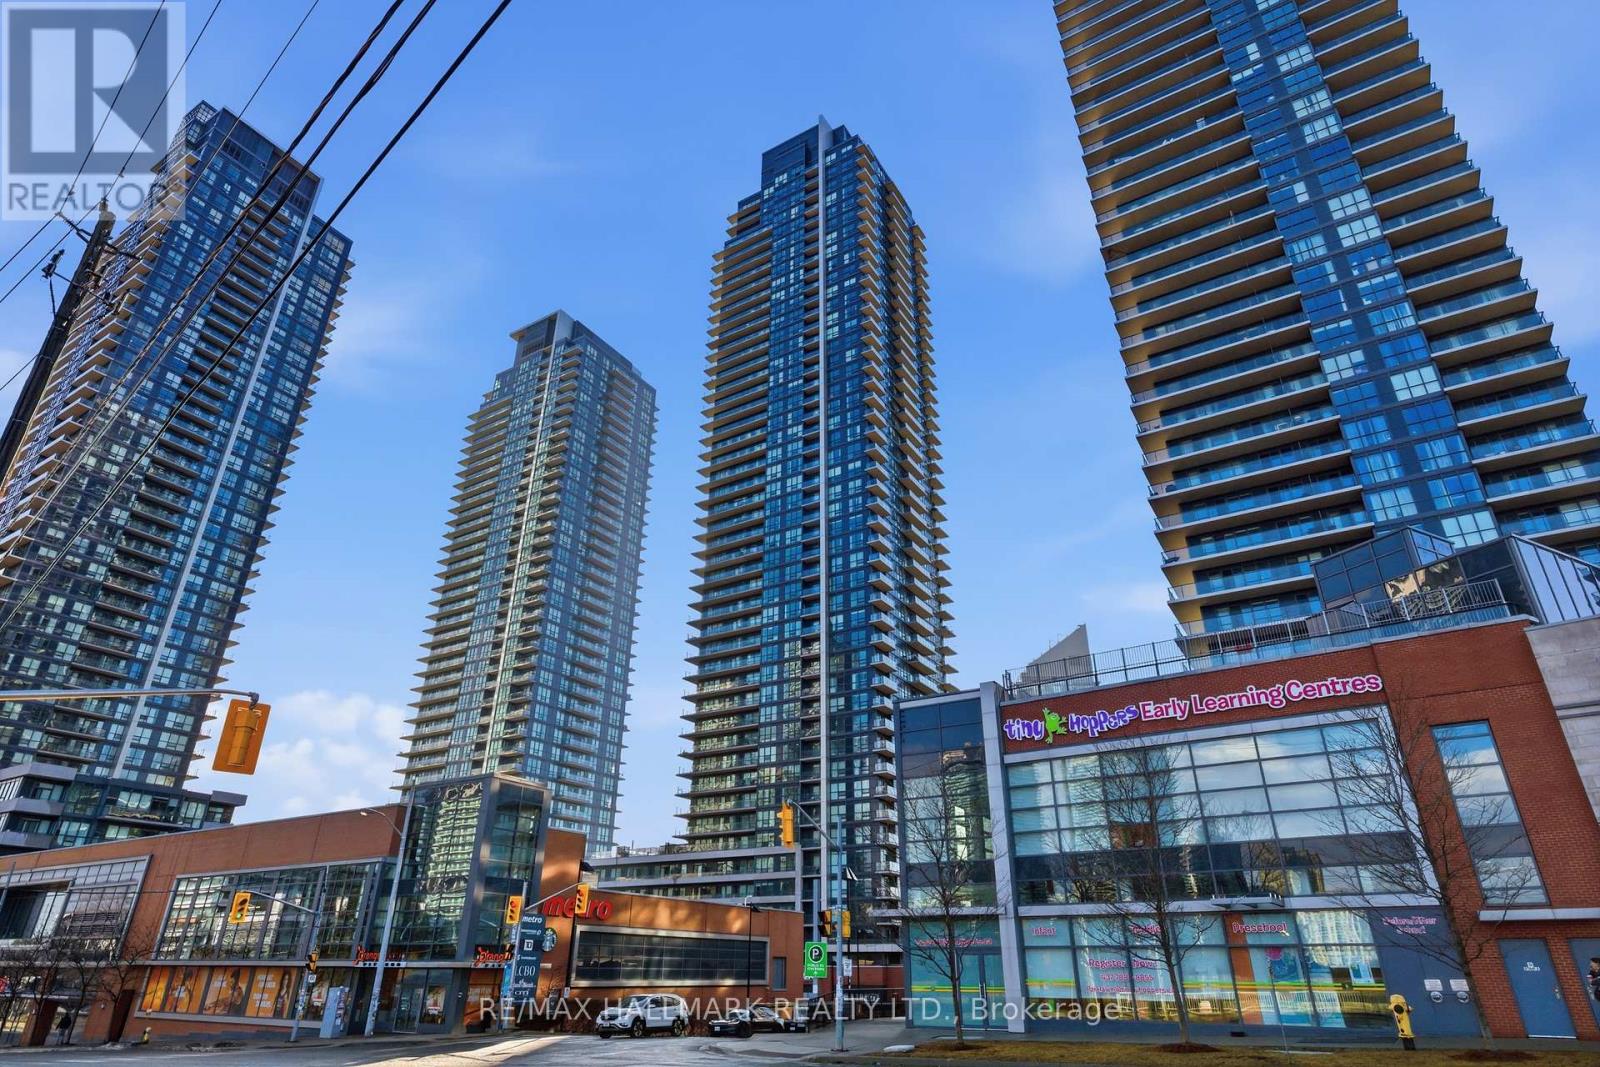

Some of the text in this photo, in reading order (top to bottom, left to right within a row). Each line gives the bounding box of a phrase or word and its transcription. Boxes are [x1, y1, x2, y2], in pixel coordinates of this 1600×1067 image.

[1003, 718, 1044, 740] tiny
[1139, 697, 1189, 721] Early
[1191, 684, 1286, 714] Learning
[1285, 674, 1383, 701] Centres
[542, 896, 613, 920] mero
[522, 916, 542, 924] metro
[1232, 921, 1287, 933] Preschool
